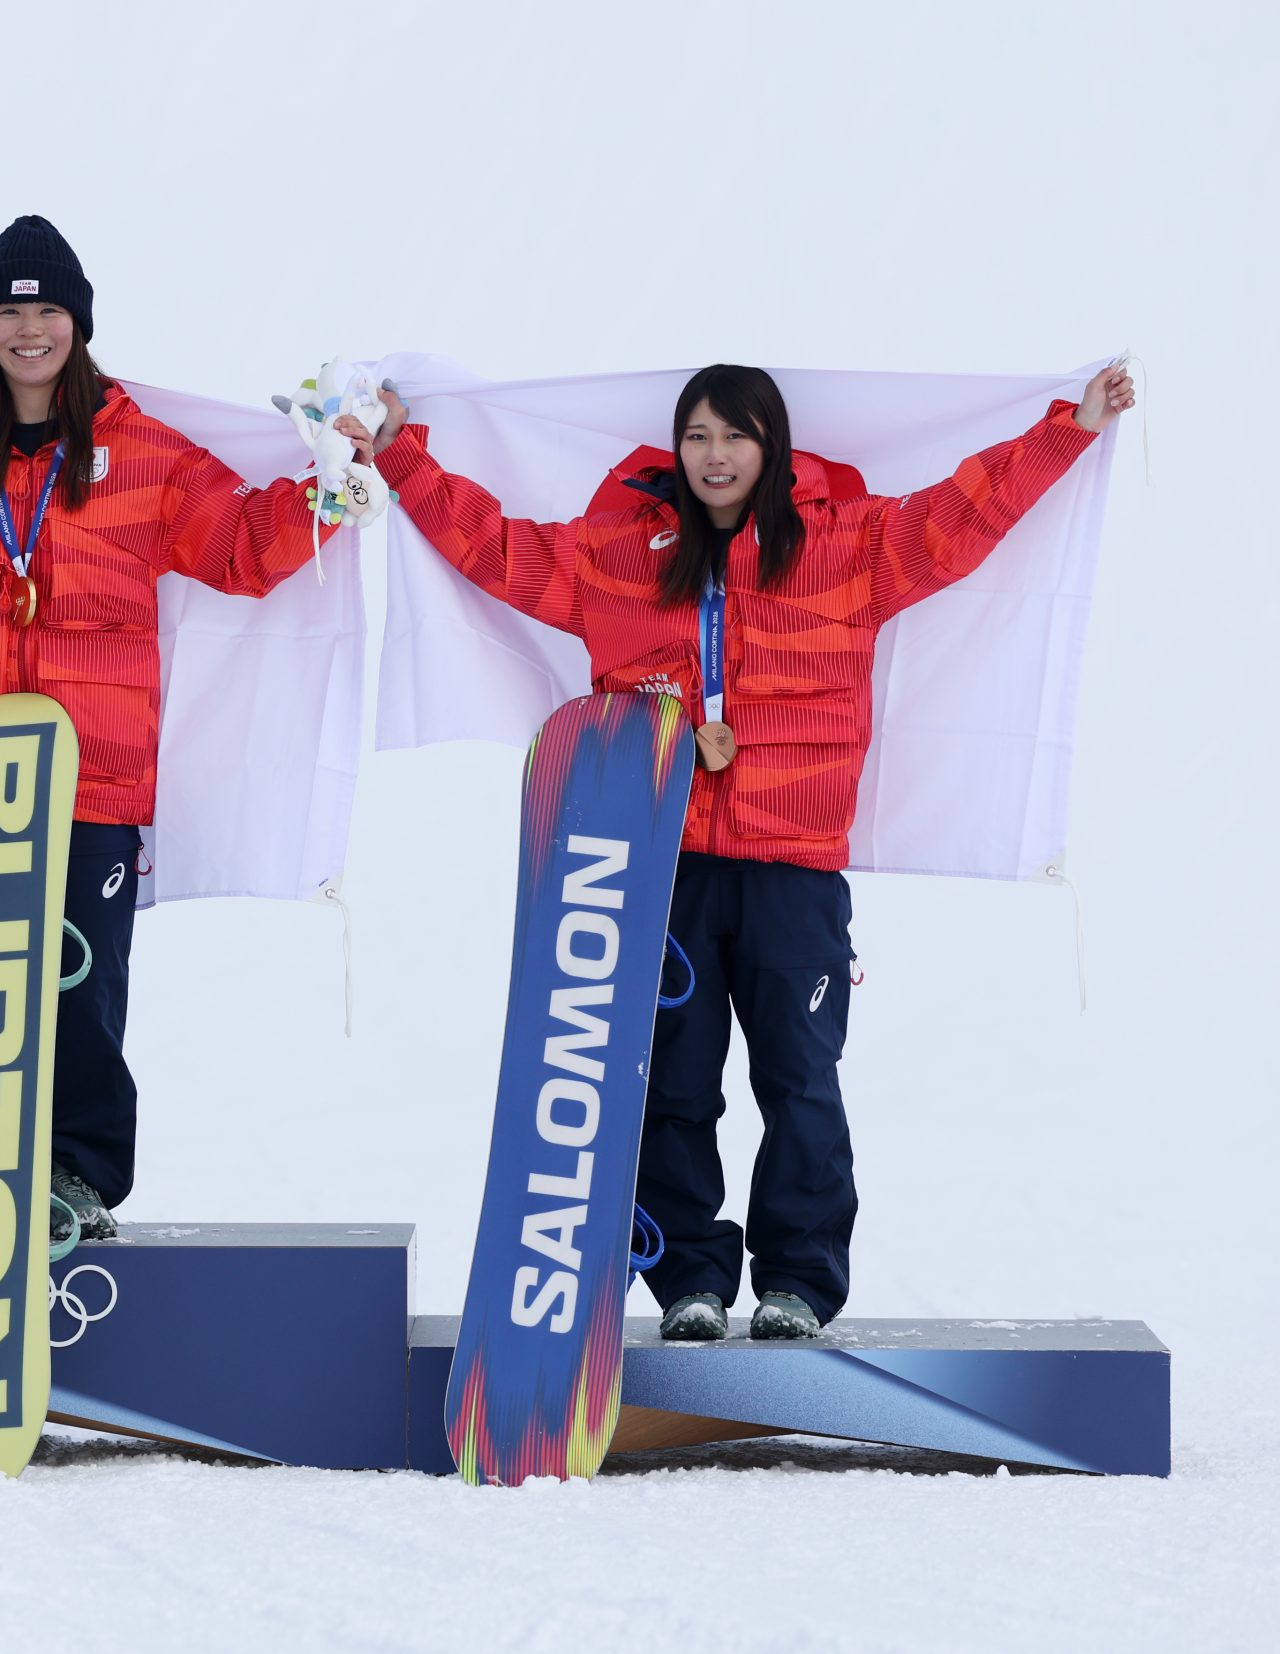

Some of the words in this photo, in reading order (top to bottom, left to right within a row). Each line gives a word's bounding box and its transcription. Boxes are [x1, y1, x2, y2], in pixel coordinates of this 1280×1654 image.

[233, 482, 252, 497] TEA
[2, 520, 13, 546] MILANO
[711, 625, 719, 653] CORTINA
[640, 672, 669, 683] TEAM
[510, 834, 630, 1335] SALOMON
